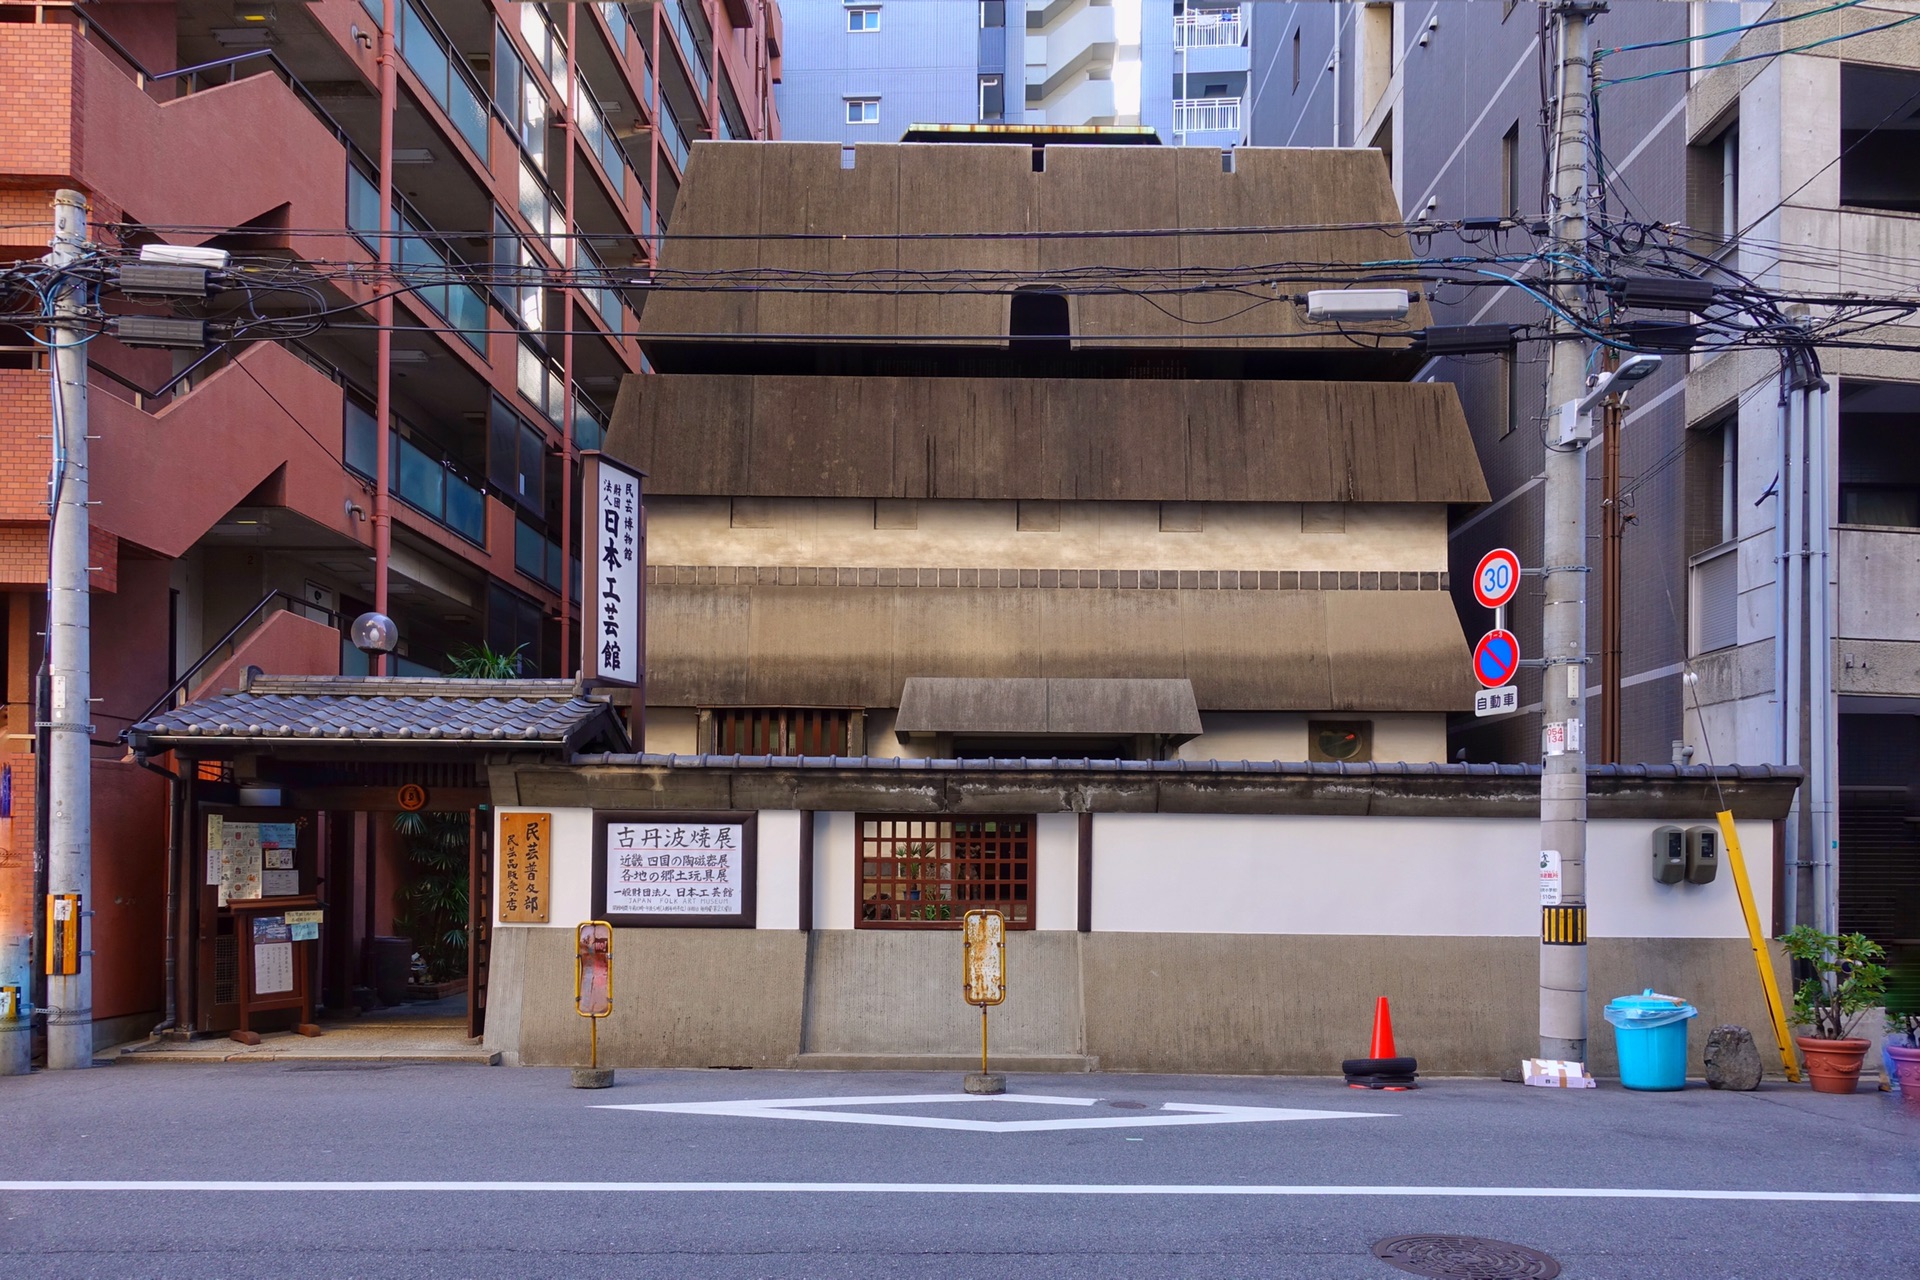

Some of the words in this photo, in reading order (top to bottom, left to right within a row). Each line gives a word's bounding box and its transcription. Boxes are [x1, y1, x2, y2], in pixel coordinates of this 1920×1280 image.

[603, 479, 613, 506] 法人
[613, 483, 622, 509] 財団
[624, 483, 634, 562] 民芸博物館
[601, 508, 623, 672] 日本工芸館
[1484, 564, 1509, 593] 30
[1477, 693, 1514, 711] 自動車
[1546, 727, 1563, 736] 054
[617, 826, 737, 849] 古丹波焼展
[506, 834, 519, 911] 民芸品販売の店
[523, 822, 540, 914] 民芸普及部
[647, 854, 730, 869] 四国の陶磁器展
[621, 869, 729, 883] 各地の郷土玩具展
[613, 887, 671, 897] 一般財団法人
